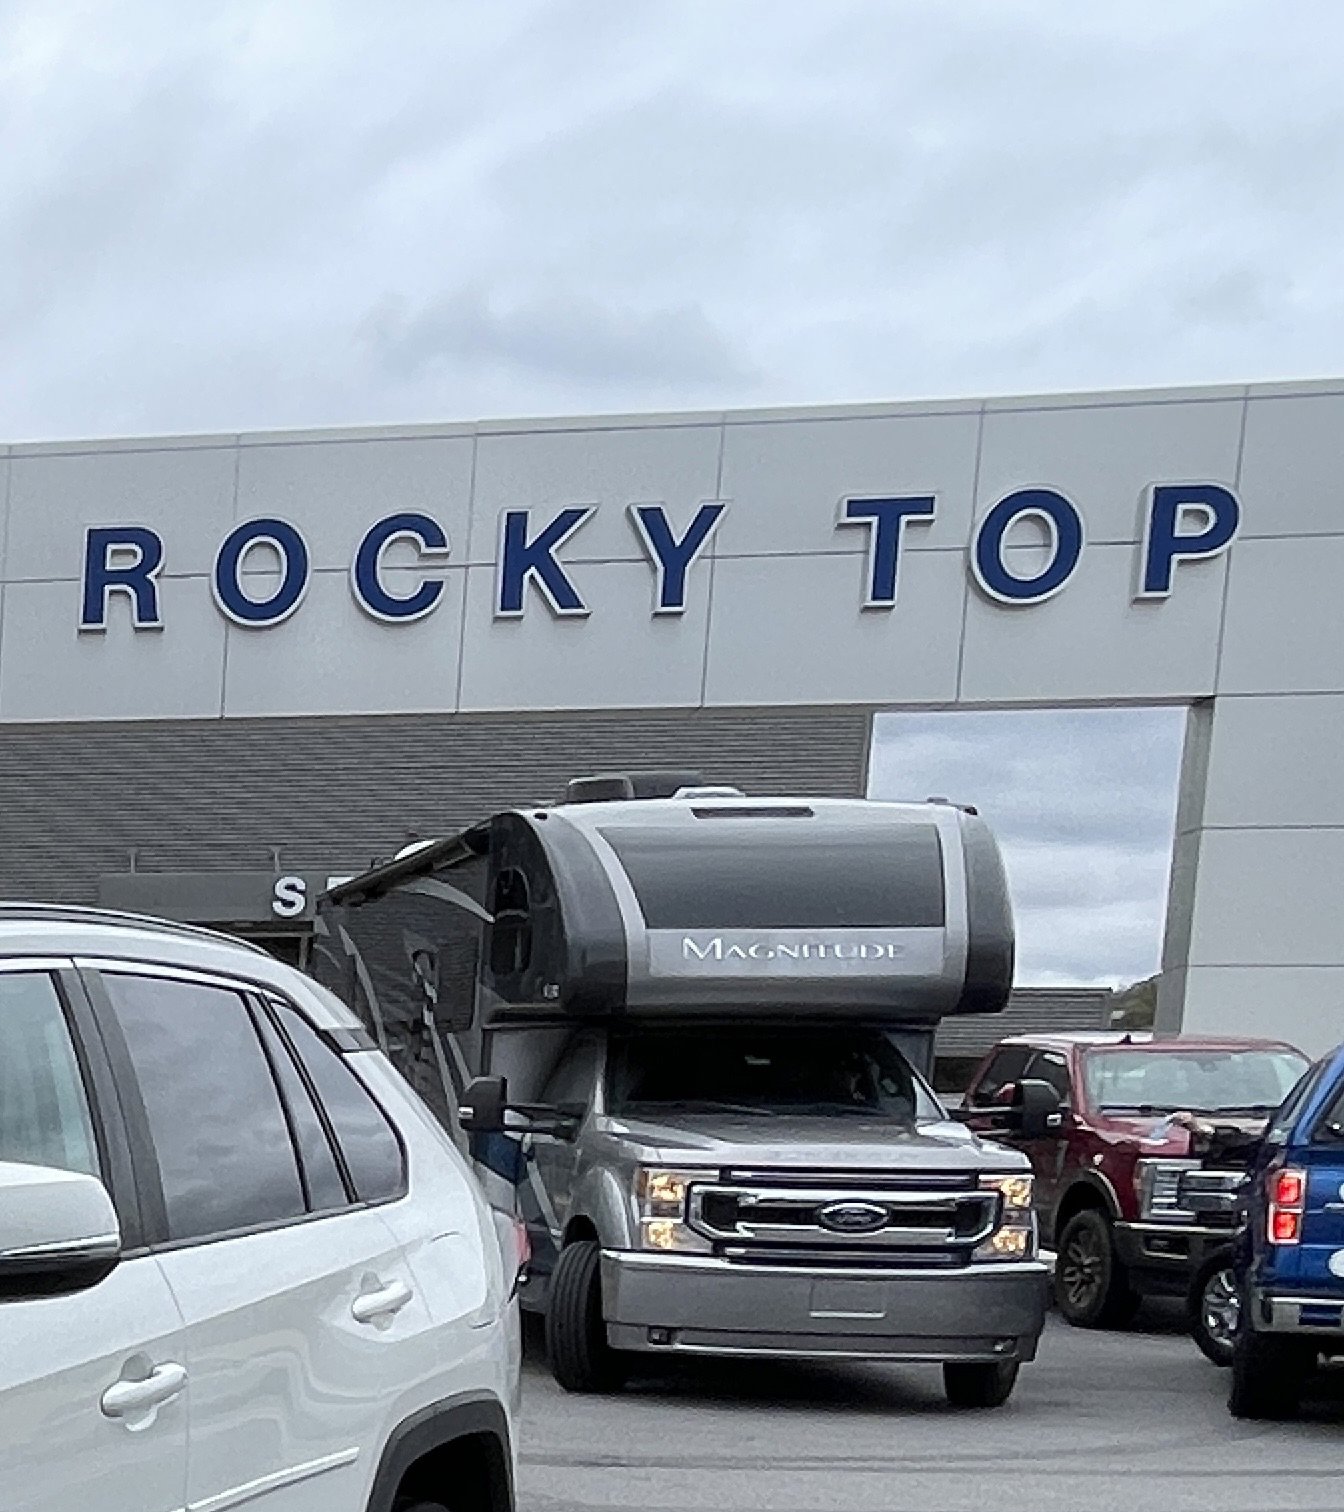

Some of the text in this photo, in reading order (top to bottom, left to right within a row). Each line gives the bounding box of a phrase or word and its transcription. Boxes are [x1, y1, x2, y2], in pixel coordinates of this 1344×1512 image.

[78, 480, 1240, 635] ROCKY TOP
[682, 936, 905, 960] MAGNITUDE
